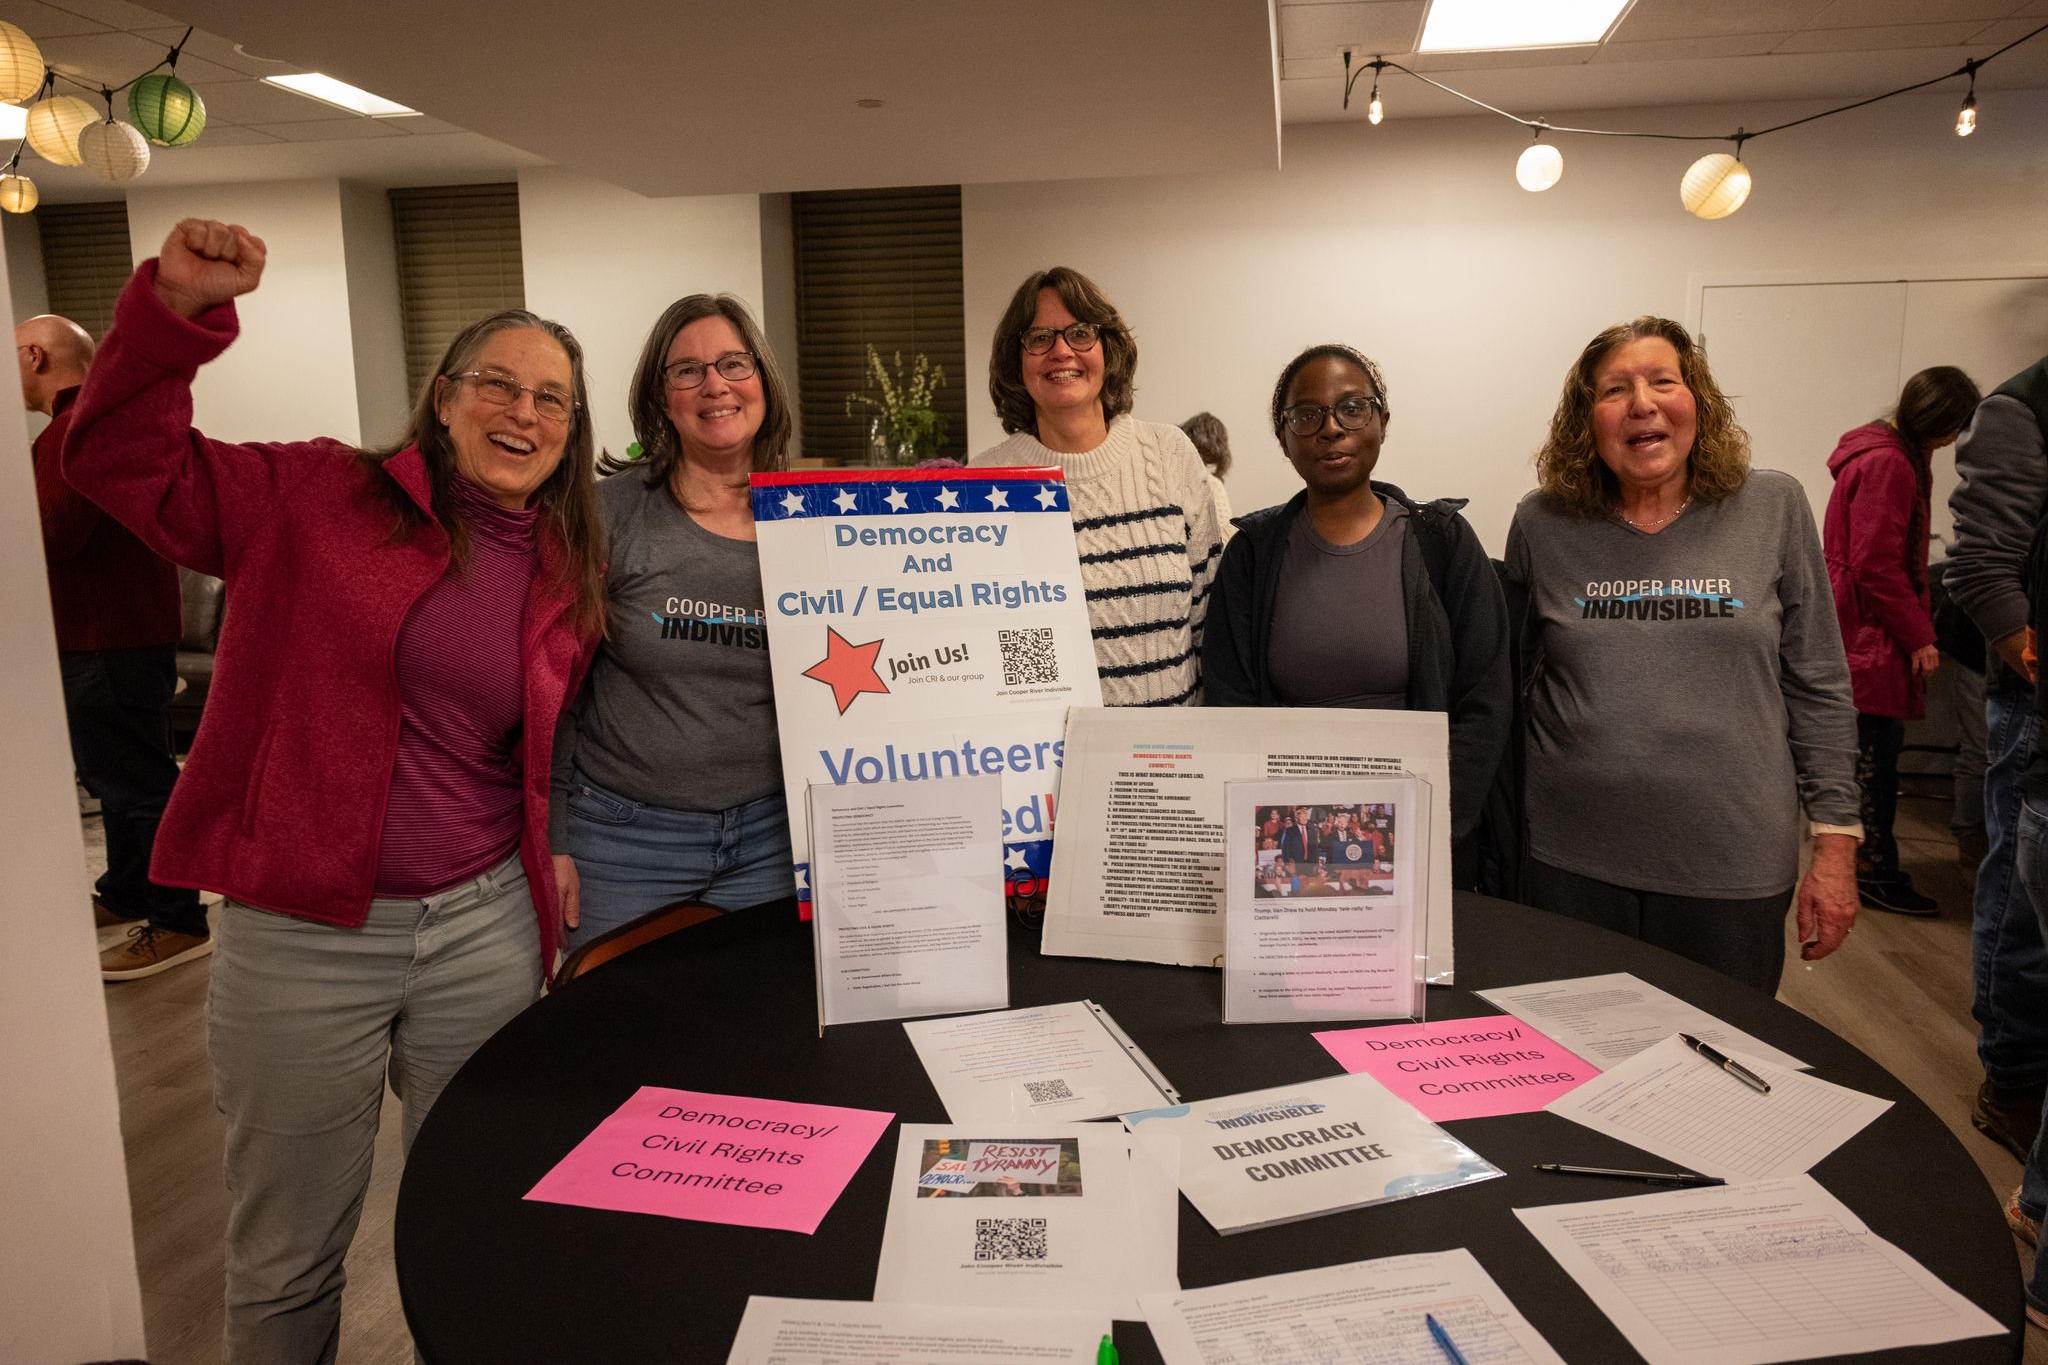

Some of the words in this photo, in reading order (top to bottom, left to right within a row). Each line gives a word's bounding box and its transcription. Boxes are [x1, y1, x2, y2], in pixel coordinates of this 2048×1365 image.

[835, 523, 1008, 547] Democracy
[902, 553, 953, 574] And
[777, 588, 844, 617] Civil
[852, 586, 868, 617] /
[876, 585, 963, 614] Equal
[971, 579, 1067, 609] Rights
[1586, 580, 1663, 597] COOPER
[1671, 578, 1731, 595] RIVER
[666, 596, 747, 624] COOPER
[1582, 597, 1735, 621] INDIVISIBLE
[888, 652, 931, 681] Join
[935, 643, 970, 666] Us!
[926, 675, 938, 683] CRI
[962, 673, 985, 682] group
[1365, 1026, 1522, 1052] Democracy/
[1396, 1055, 1458, 1074] Civil
[1459, 1047, 1545, 1067] Rights
[1418, 1070, 1575, 1097] Committee
[658, 1105, 838, 1141] Democracy/
[1215, 1104, 1324, 1130] INDIVISIBLE
[641, 1134, 703, 1155] Civil
[710, 1142, 805, 1166] Rights
[982, 1144, 1055, 1159] RESIST
[1213, 1121, 1368, 1161] DEMOCRACY
[972, 1157, 1057, 1176] TYRANNY
[1244, 1142, 1393, 1183] COMMITTEE
[611, 1161, 784, 1197] Committee
